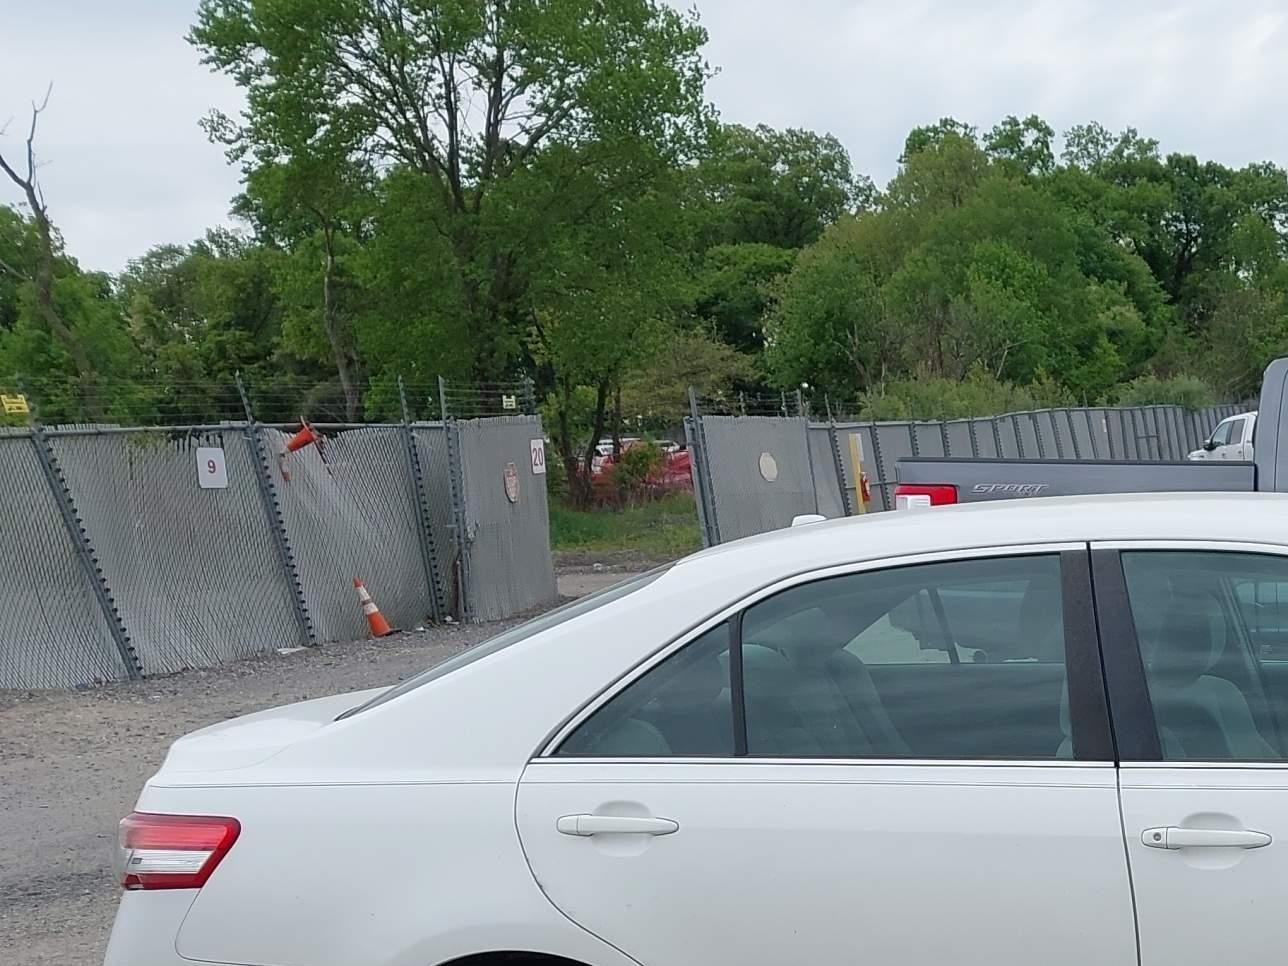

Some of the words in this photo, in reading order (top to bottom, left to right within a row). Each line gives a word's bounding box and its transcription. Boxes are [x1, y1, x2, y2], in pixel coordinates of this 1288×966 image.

[532, 447, 543, 467] 20
[207, 459, 217, 474] 9
[971, 483, 1049, 494] SPORT
